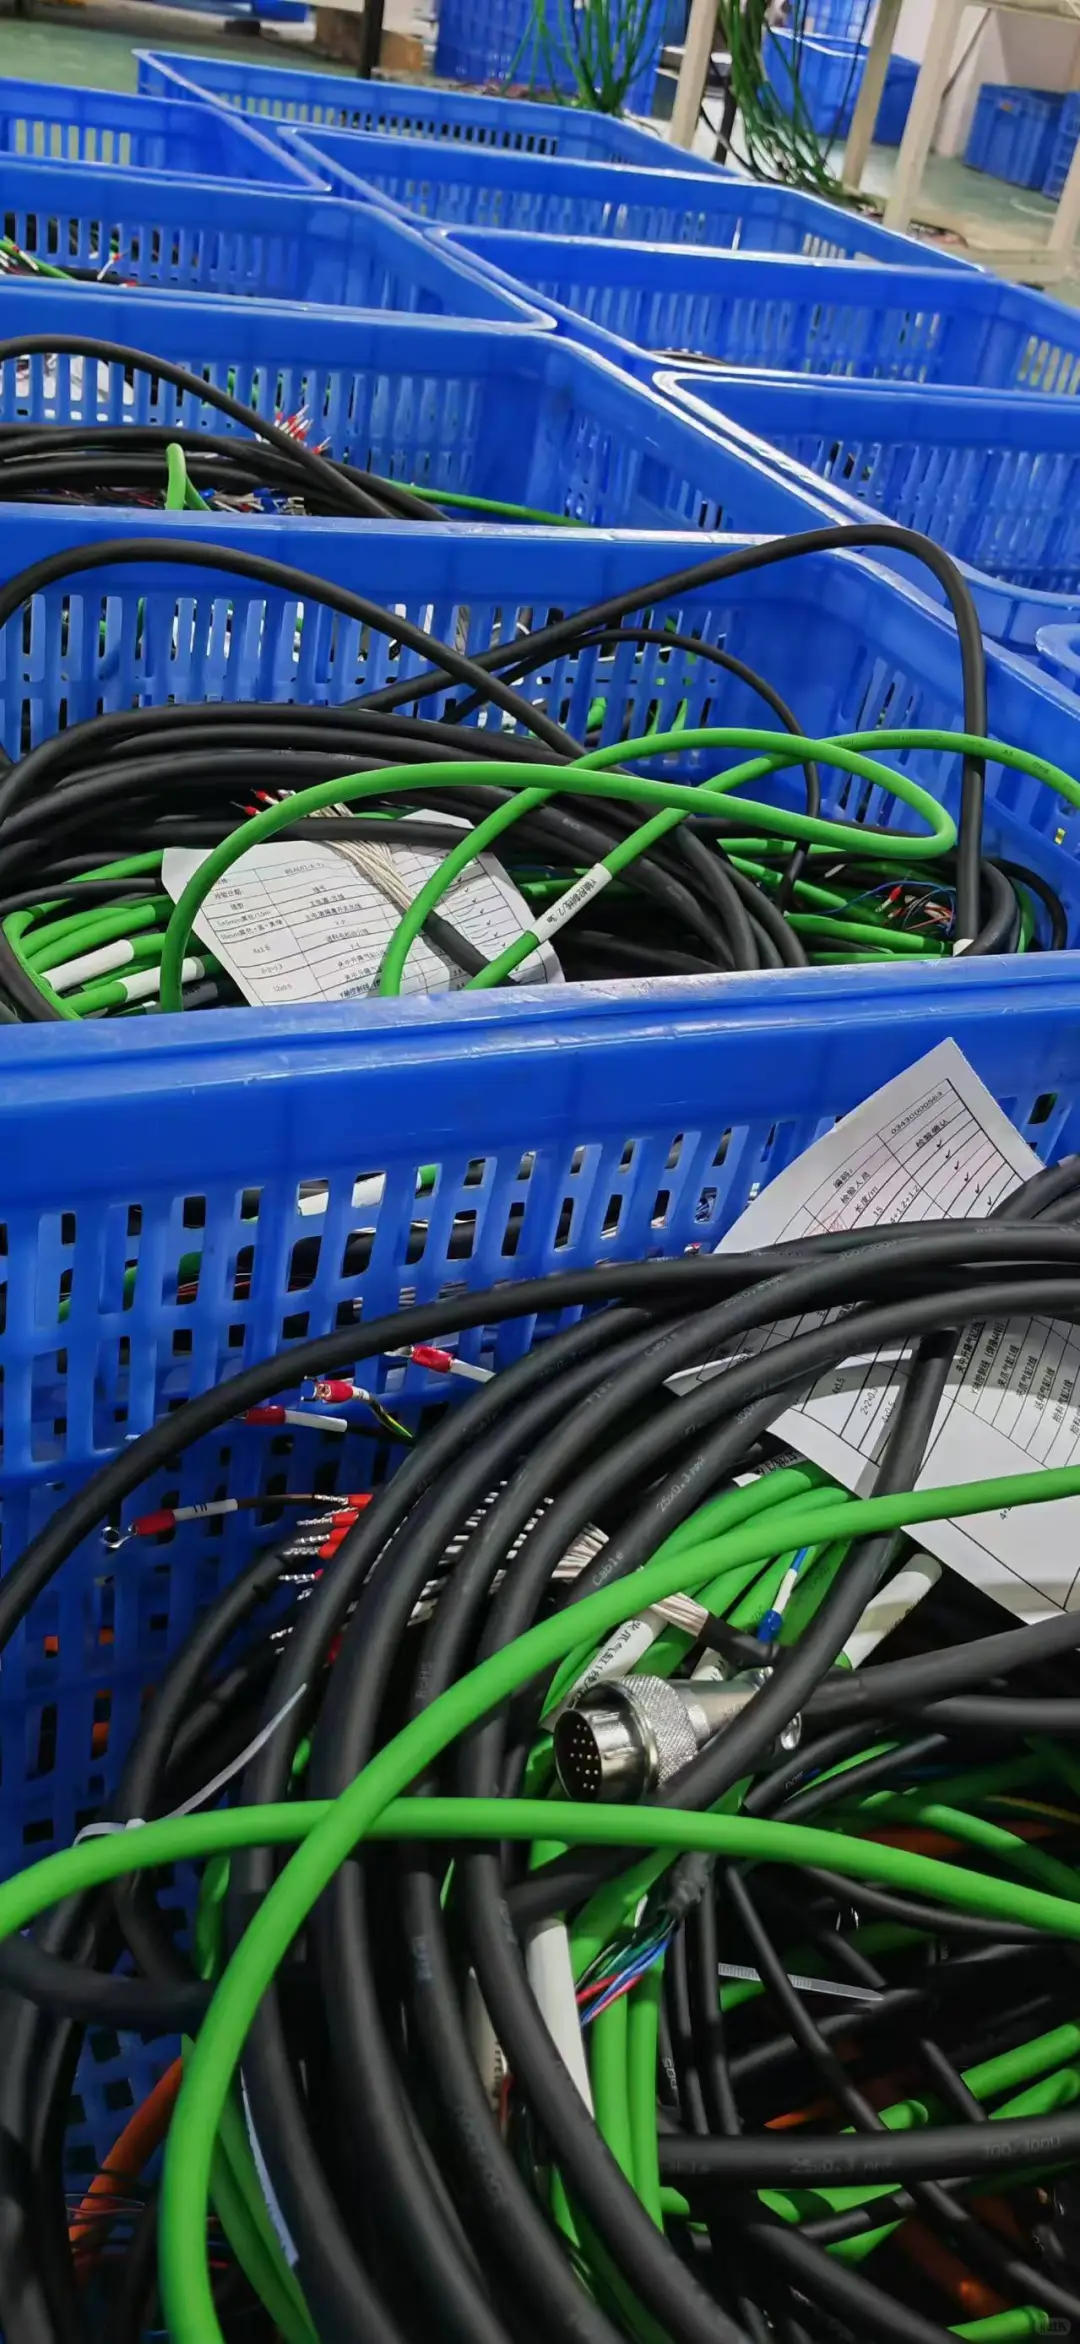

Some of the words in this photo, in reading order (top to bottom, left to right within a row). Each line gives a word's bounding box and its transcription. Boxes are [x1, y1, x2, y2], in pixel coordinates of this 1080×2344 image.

[915, 1118, 950, 1149] 检验确认
[840, 1171, 871, 1204] 检验人员
[854, 1185, 880, 1214] 长度/m
[872, 1205, 884, 1217] 15
[592, 1549, 626, 1587] Cable
